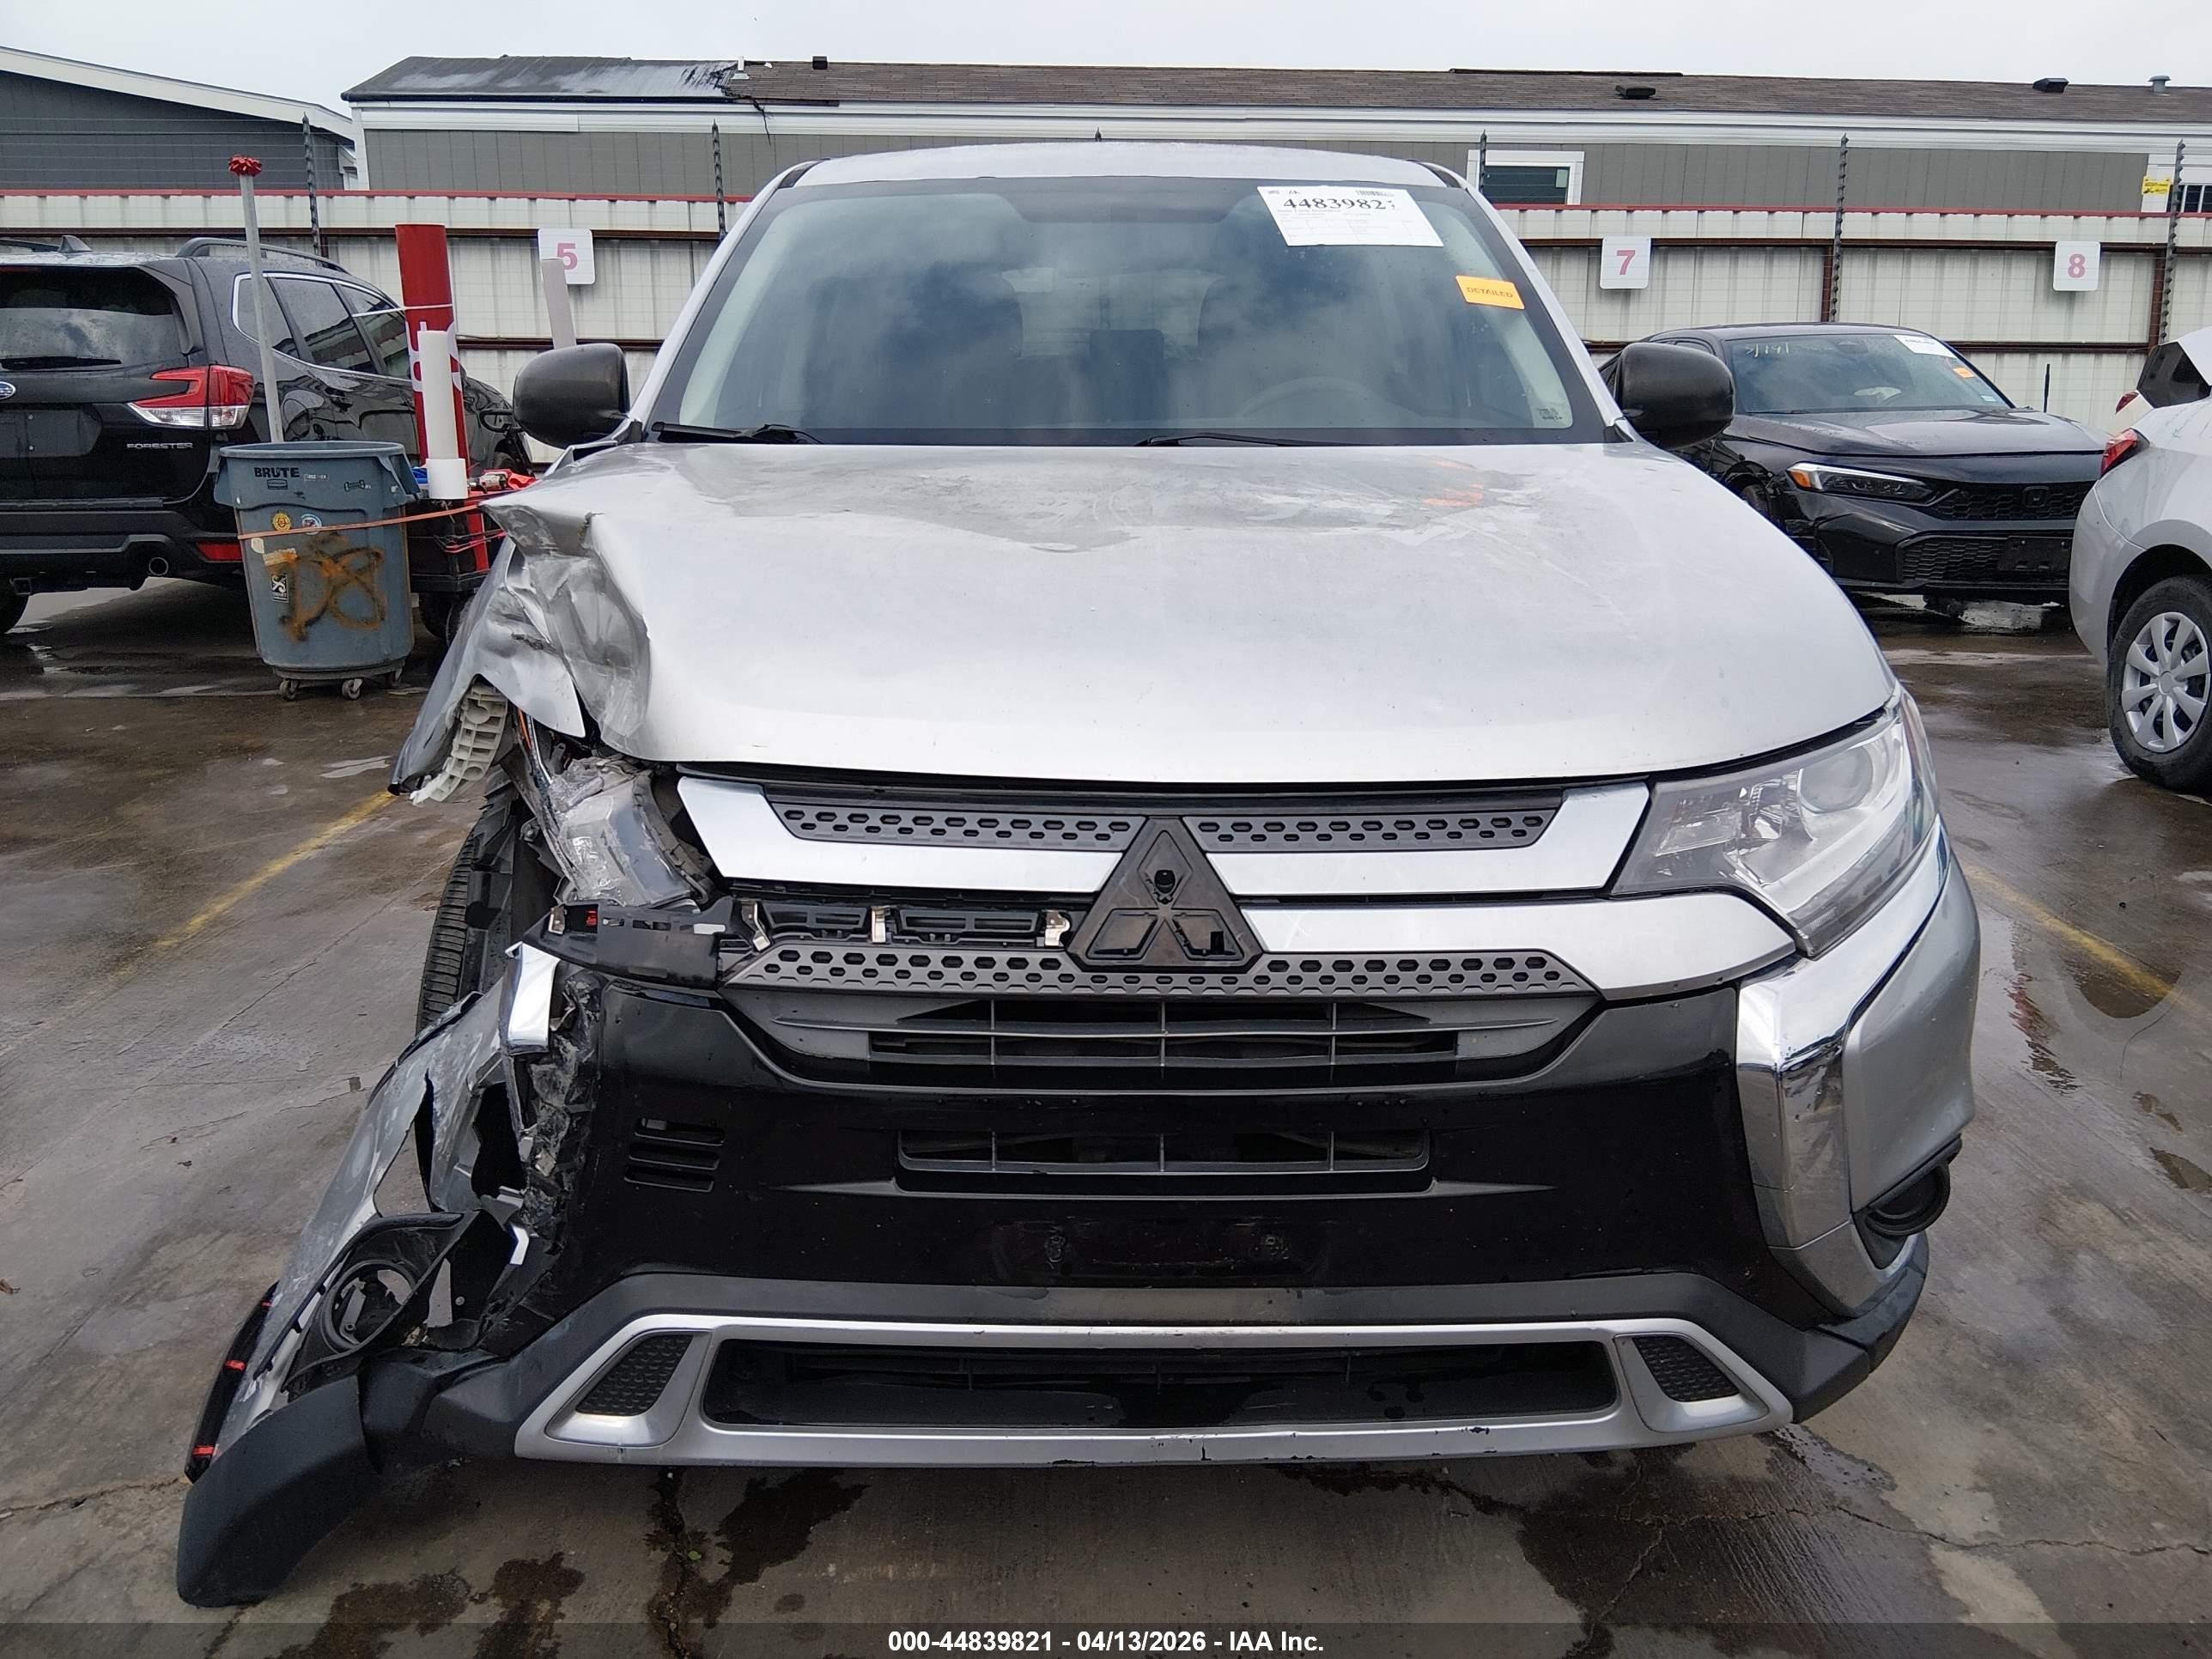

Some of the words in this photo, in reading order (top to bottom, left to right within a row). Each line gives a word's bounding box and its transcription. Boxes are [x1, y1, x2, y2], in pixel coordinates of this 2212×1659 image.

[556, 243, 577, 270] 5
[1617, 250, 1635, 275] 7
[2068, 253, 2086, 278] 8
[1467, 287, 1513, 298] DETAILED
[254, 467, 300, 477] BRUTE
